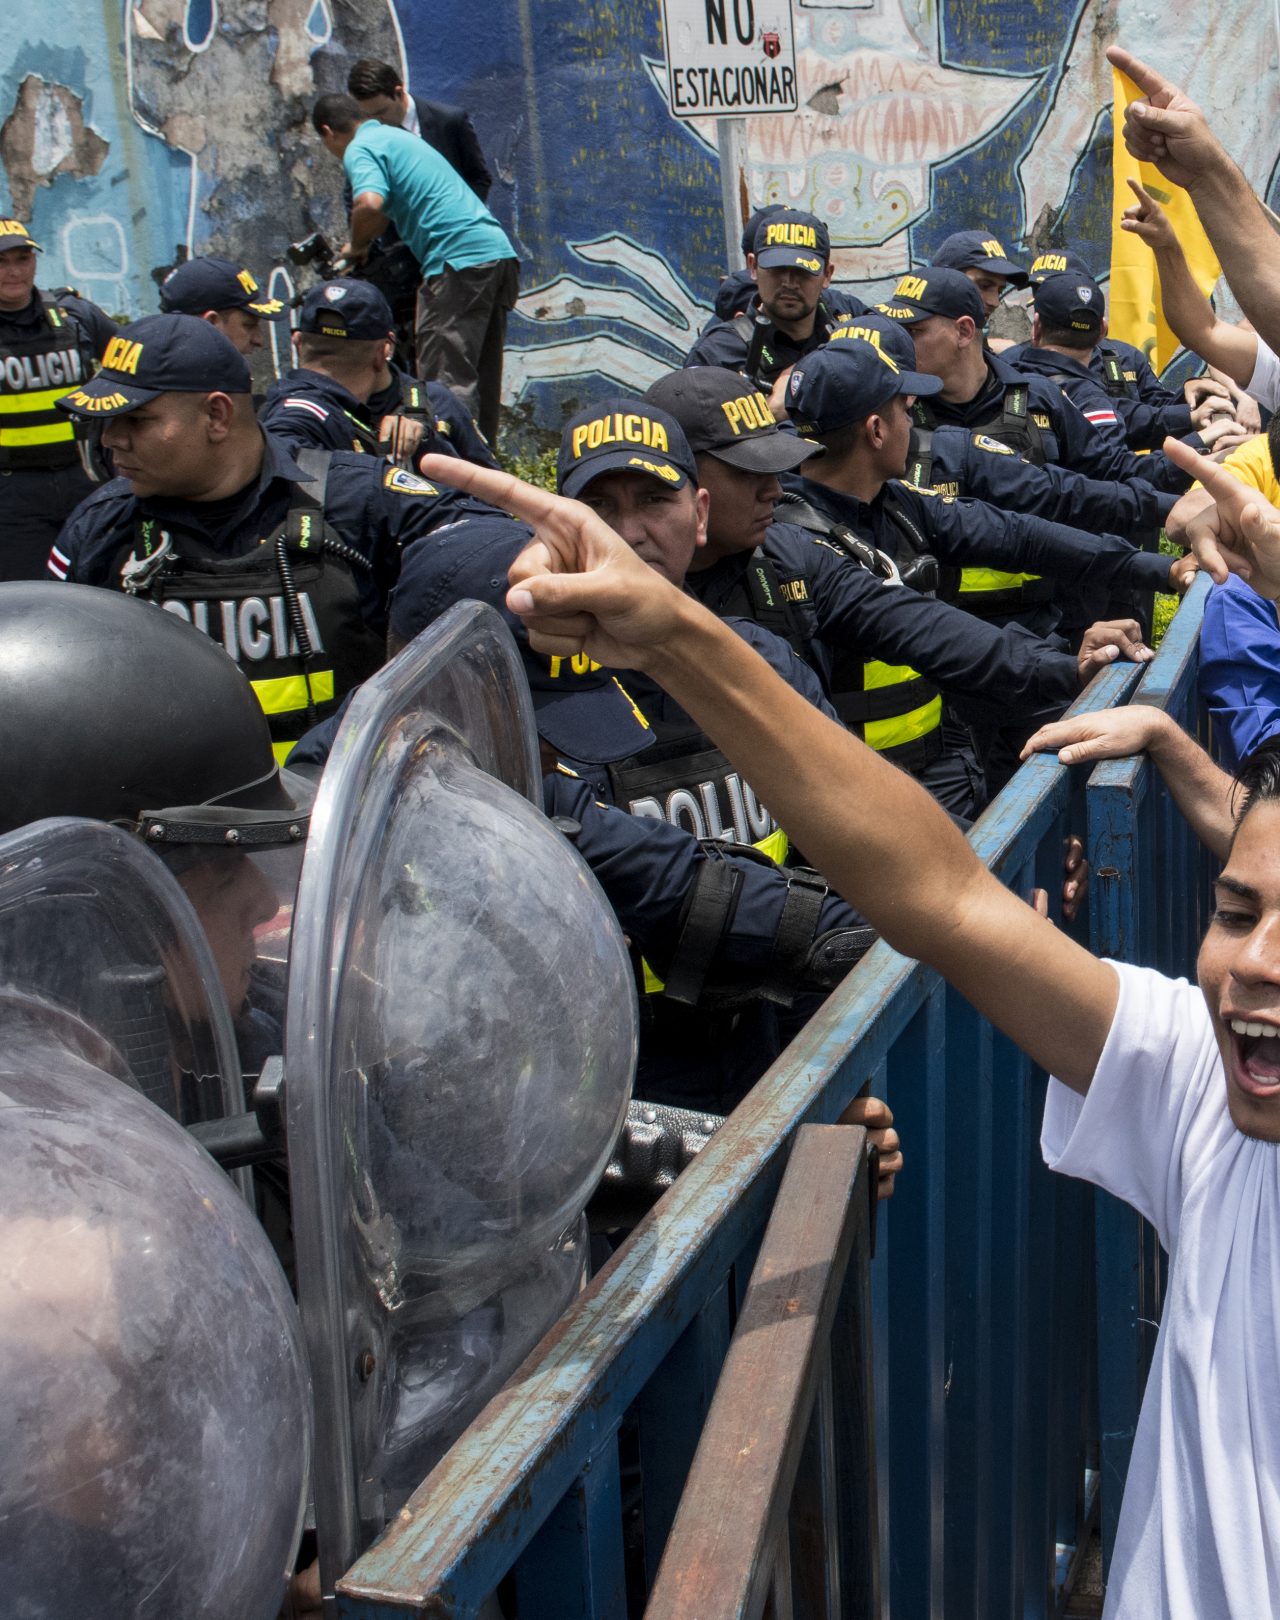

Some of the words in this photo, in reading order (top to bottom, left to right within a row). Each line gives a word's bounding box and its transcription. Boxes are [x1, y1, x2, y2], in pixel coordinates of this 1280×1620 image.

[705, 0, 755, 46] NO
[673, 66, 796, 107] ESTACIONAR
[767, 223, 817, 249] POLICIA
[66, 391, 130, 412] POLICIA
[572, 412, 669, 459] POLICIA
